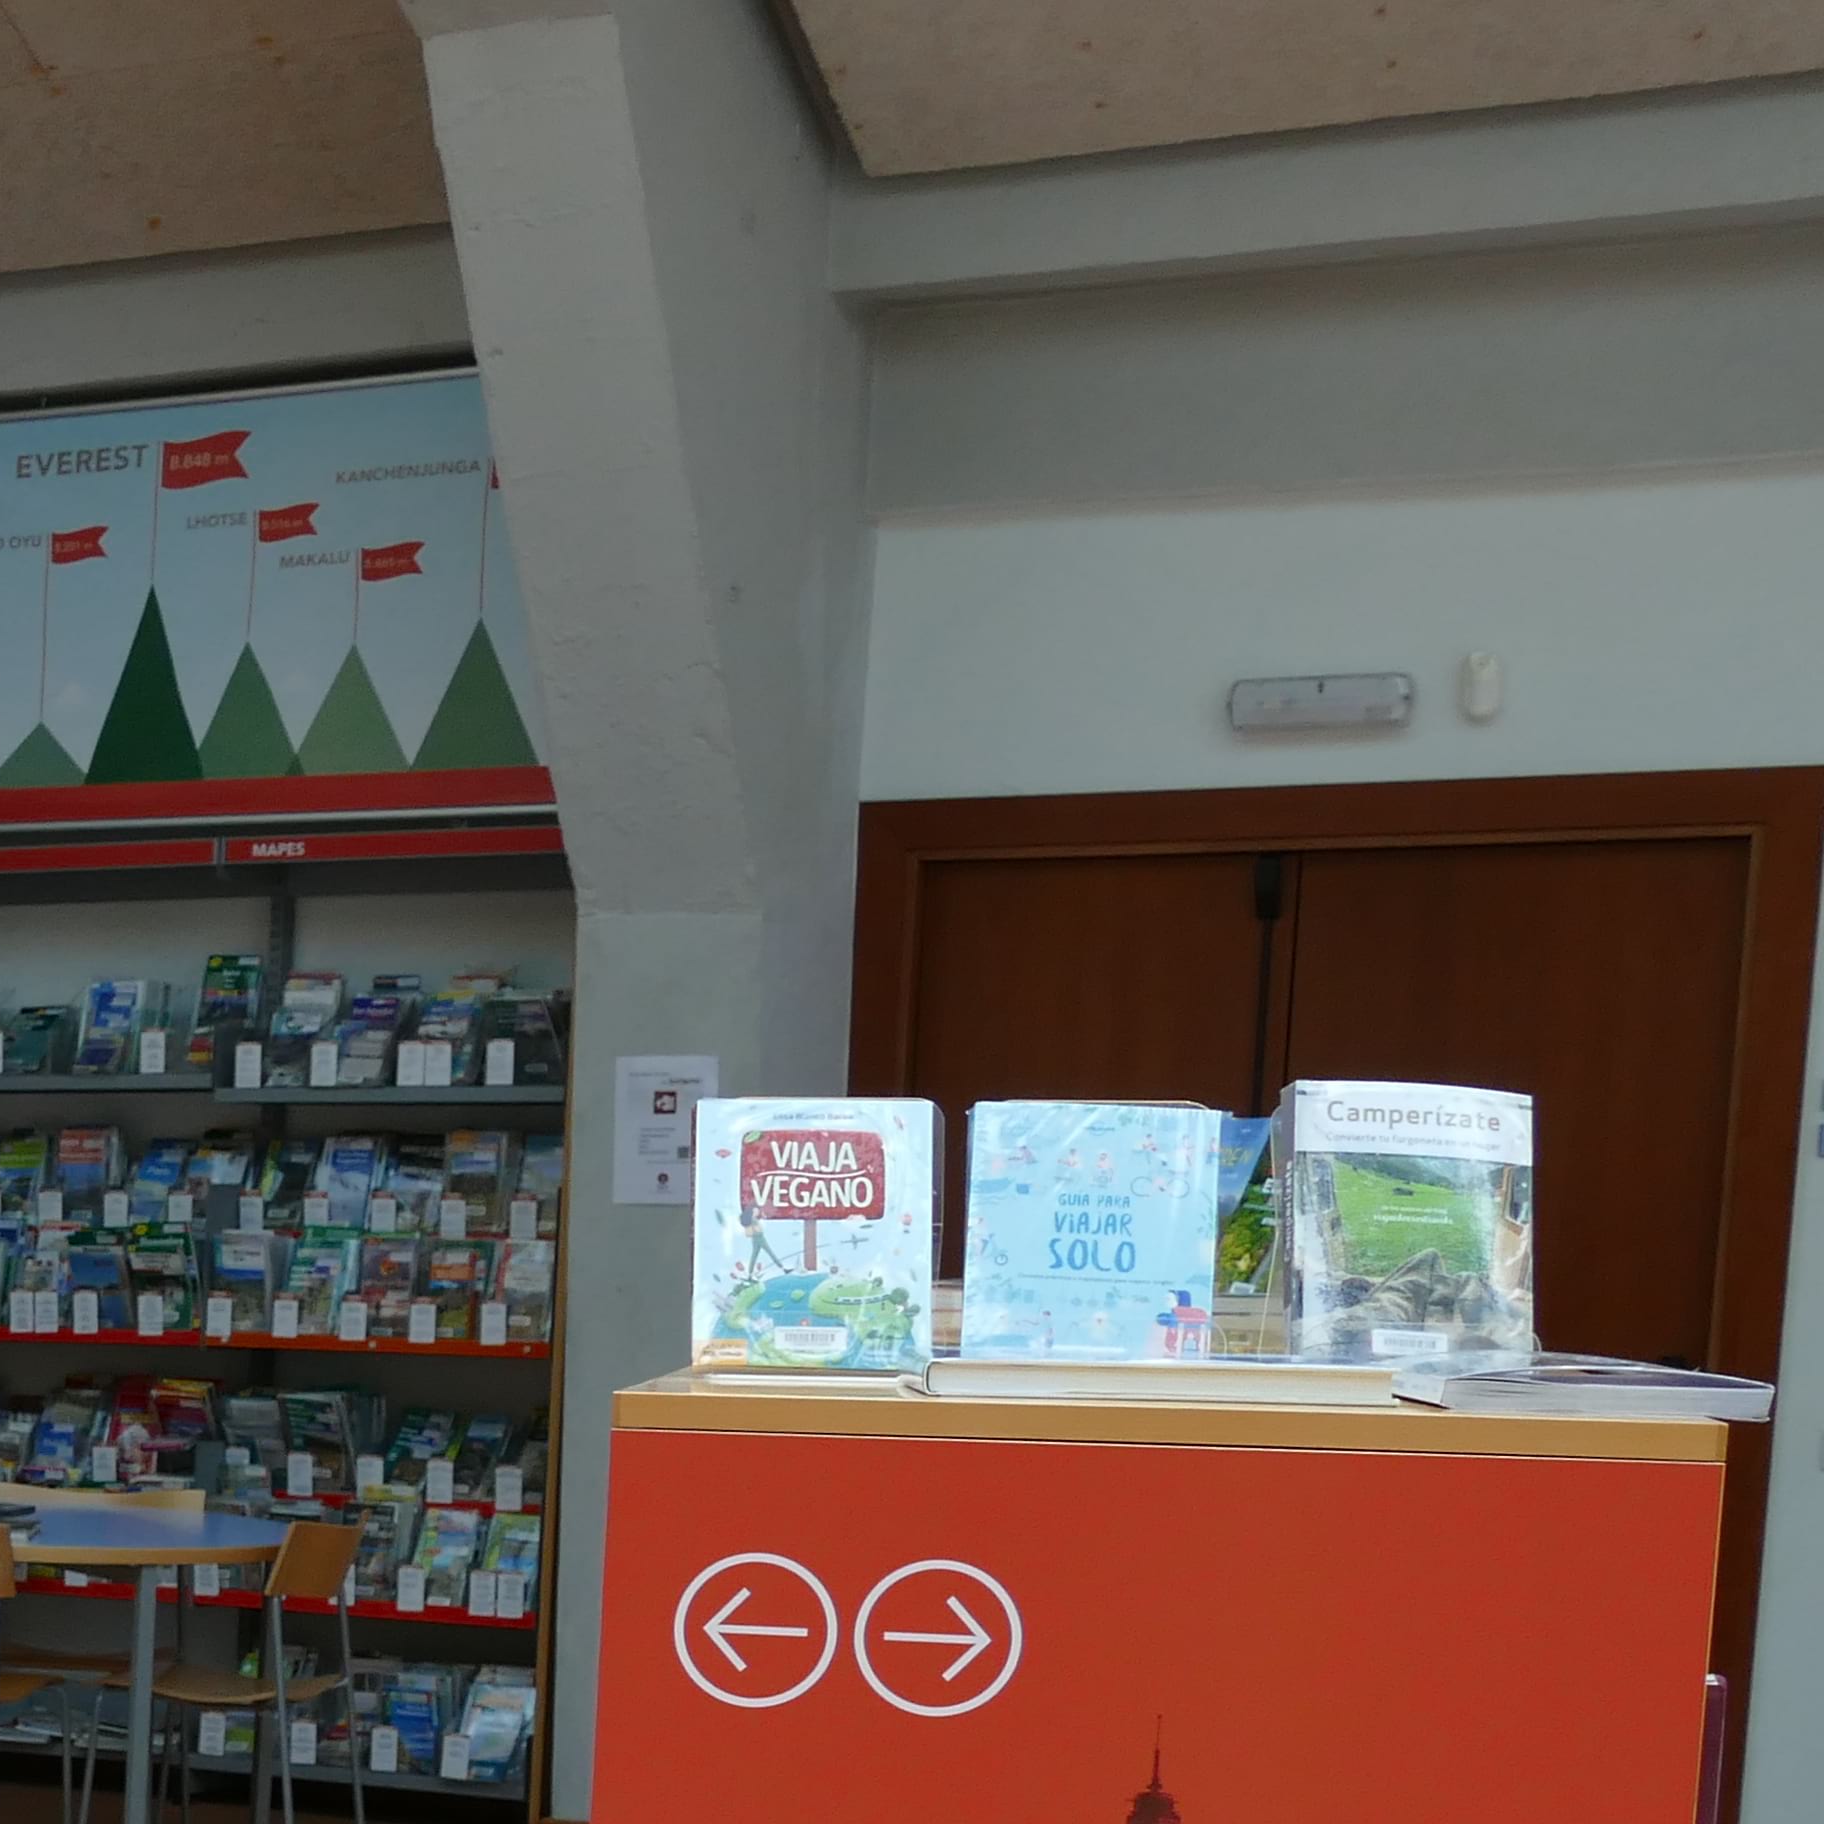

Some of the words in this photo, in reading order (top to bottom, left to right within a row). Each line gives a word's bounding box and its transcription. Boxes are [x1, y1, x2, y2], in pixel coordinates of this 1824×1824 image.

[16, 444, 150, 479] EVEREST
[336, 459, 482, 485] KANCHENJUNGA
[186, 511, 248, 531] LHOTSE
[9, 534, 42, 550] OYU
[279, 550, 351, 569] MAKALU
[252, 840, 305, 859] MAPES
[1326, 1099, 1501, 1133] Camperízate
[770, 1140, 859, 1172] VIAJA
[750, 1175, 874, 1209] VEGANO
[1097, 1194, 1131, 1208] PARA
[1048, 1237, 1137, 1273] SOLO
